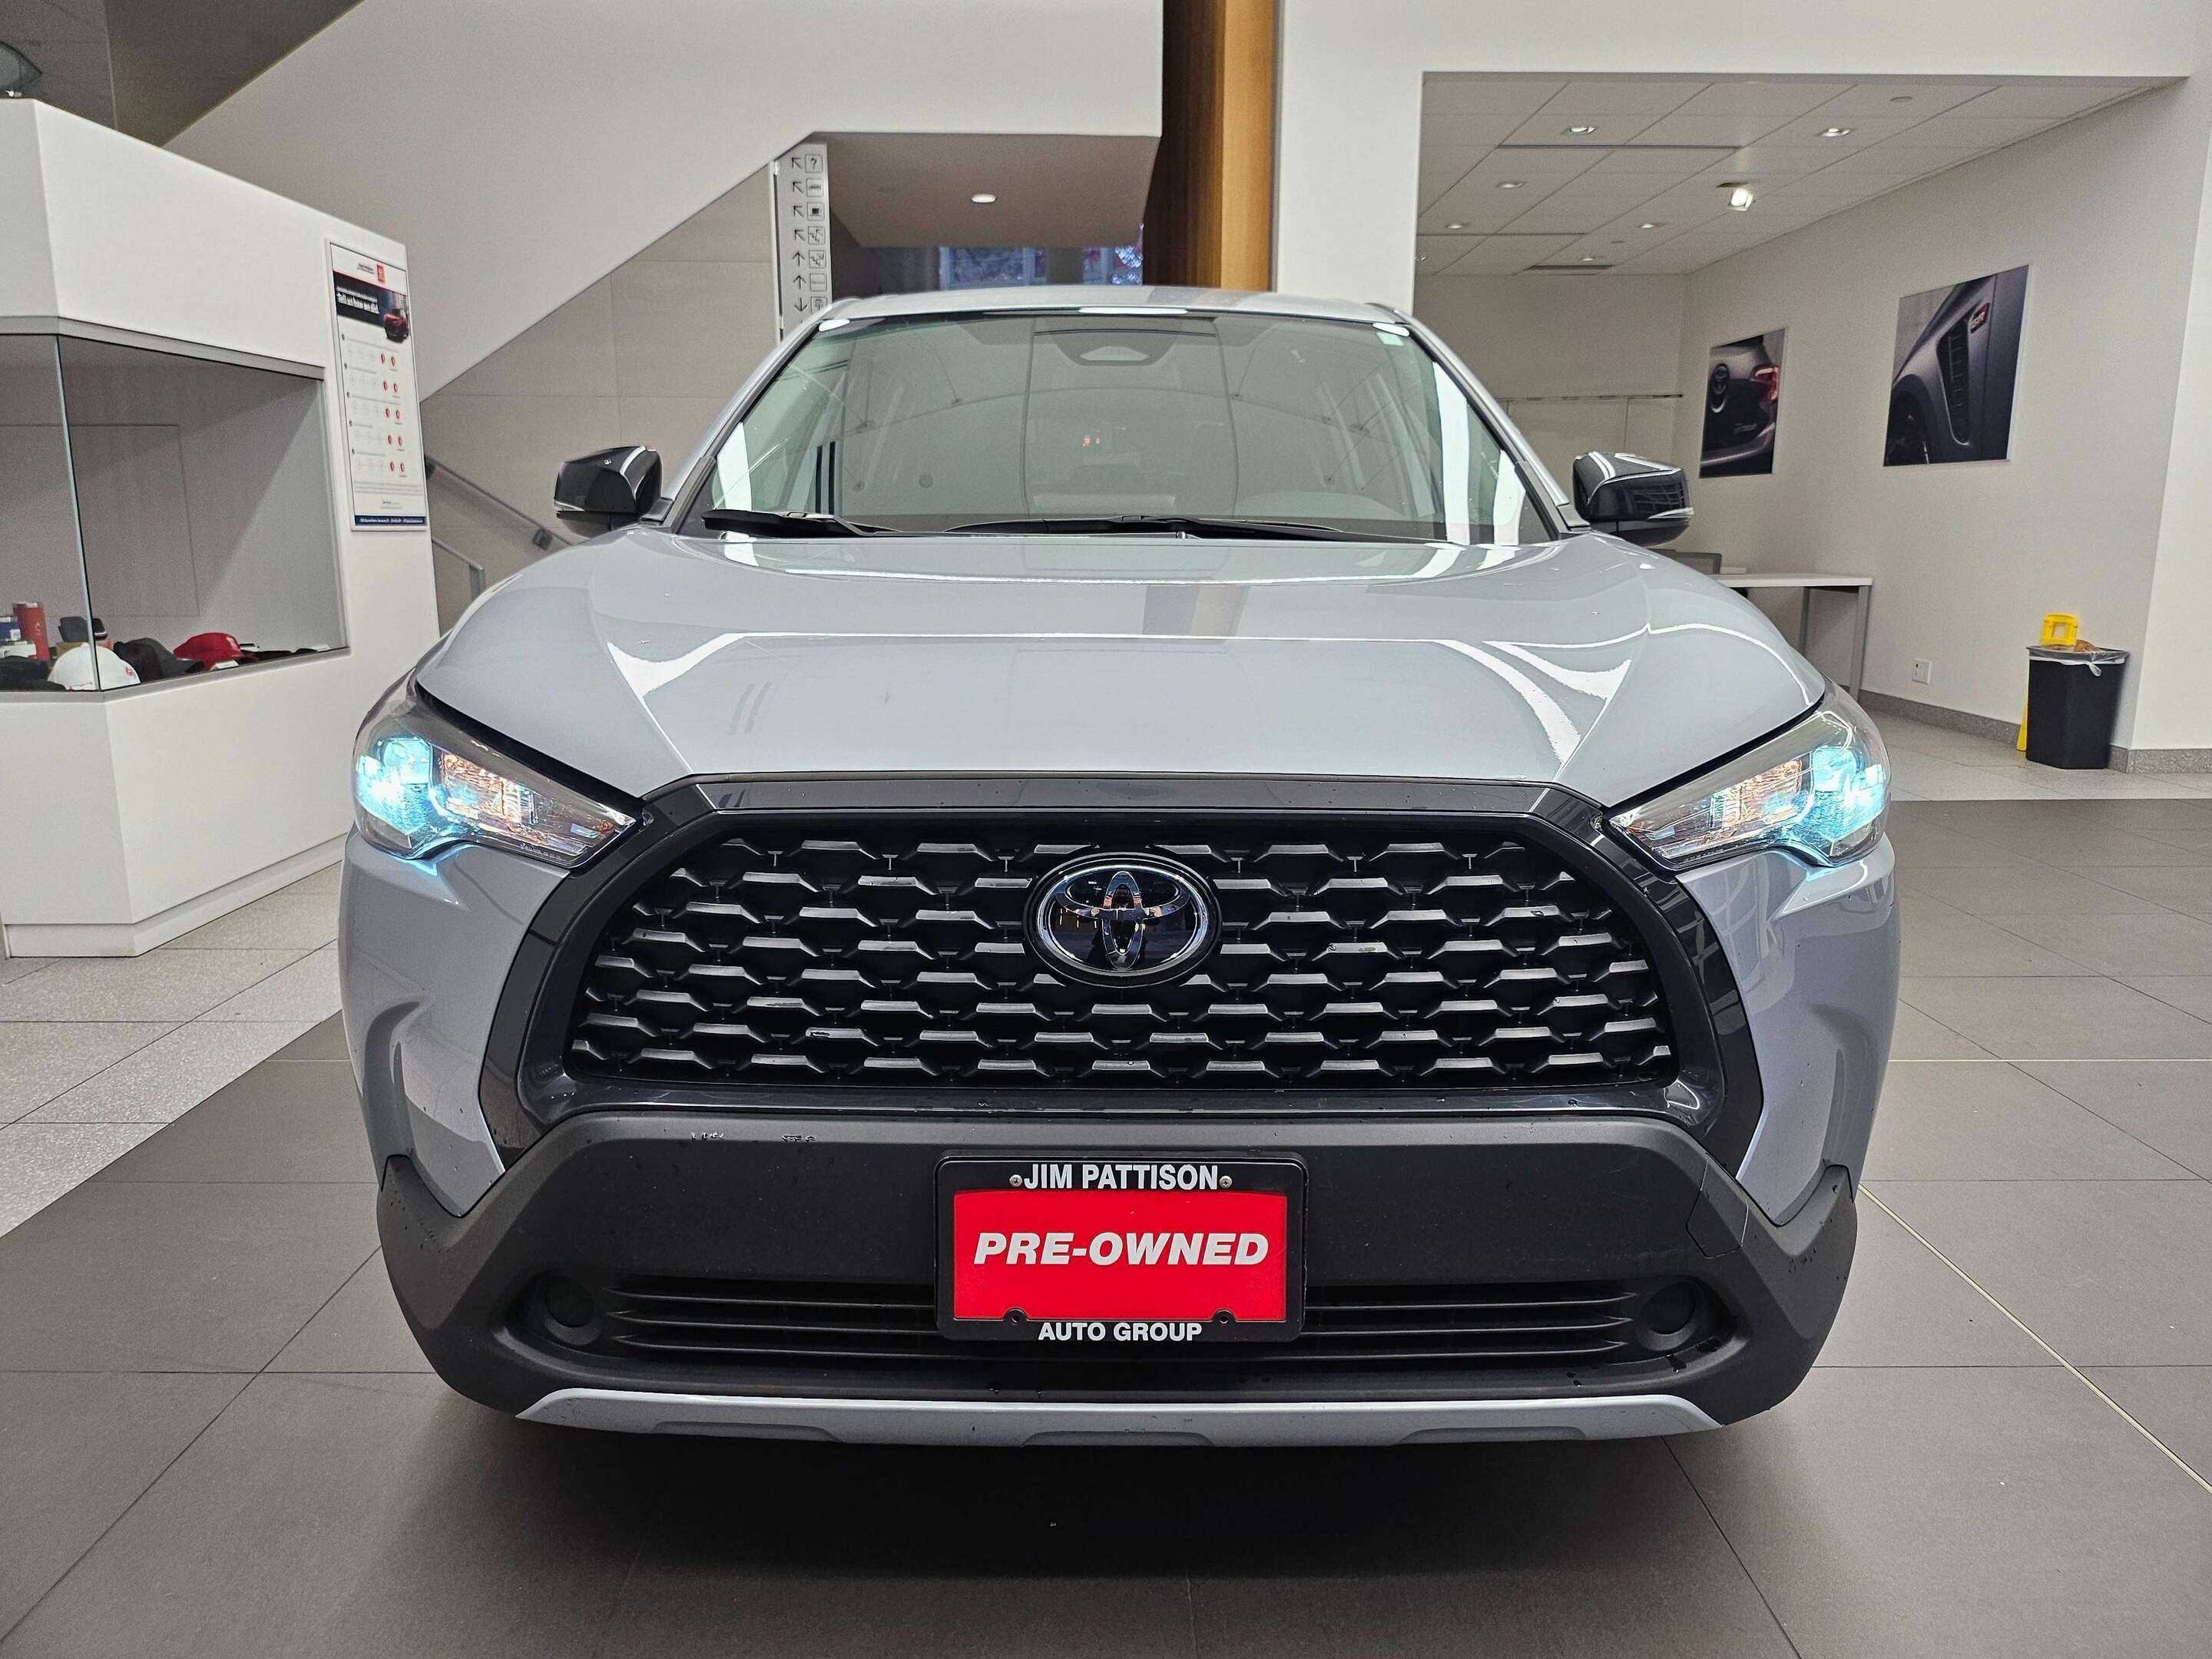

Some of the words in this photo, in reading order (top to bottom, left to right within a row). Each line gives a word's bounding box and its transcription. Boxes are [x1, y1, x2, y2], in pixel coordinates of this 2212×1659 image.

[1024, 1164, 1071, 1190] JIM
[1082, 1163, 1218, 1190] PATTISON
[973, 1232, 1269, 1266] PRE-OWNED
[1038, 1322, 1106, 1341] AUTO
[1114, 1322, 1203, 1342] GROUP
